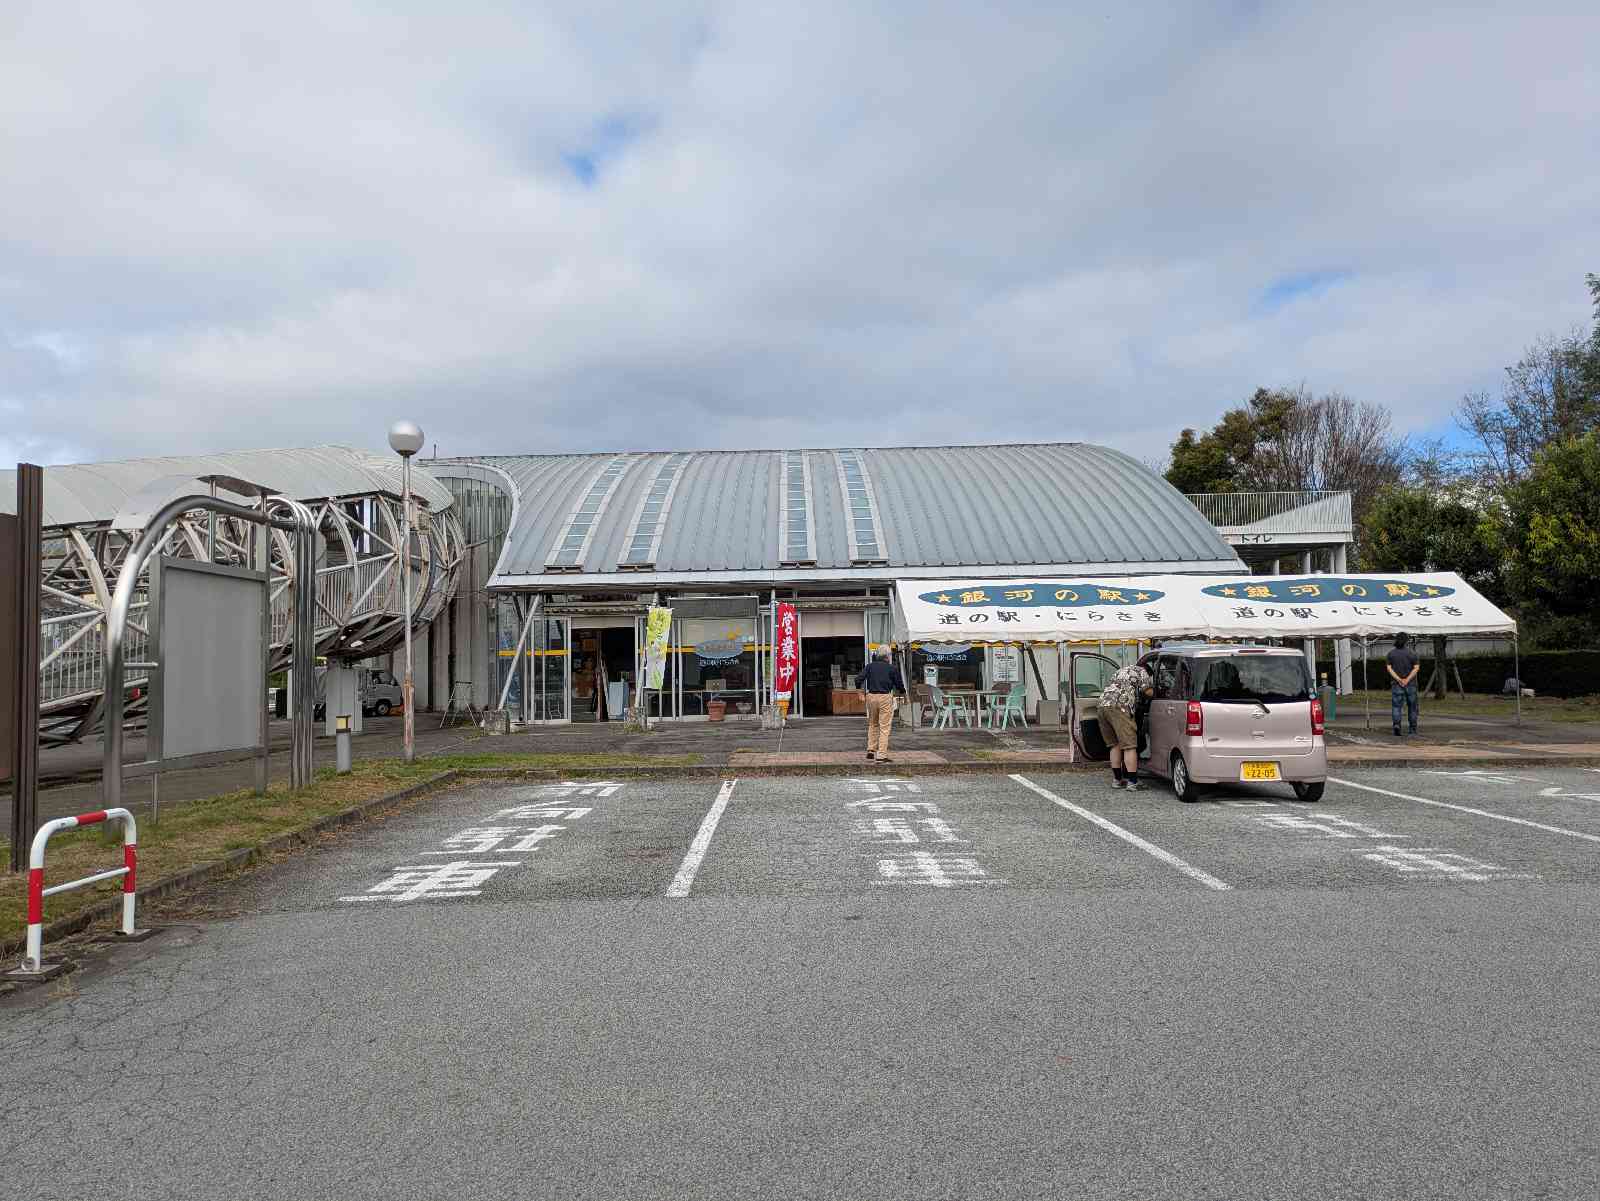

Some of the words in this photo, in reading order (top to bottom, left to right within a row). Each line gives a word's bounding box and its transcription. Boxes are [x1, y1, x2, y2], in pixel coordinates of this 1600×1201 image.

[1241, 534, 1273, 544] トイレ
[960, 589, 1129, 605] 銀河の駅
[1243, 584, 1421, 598] 銀河の駅
[779, 612, 796, 685] 営業中
